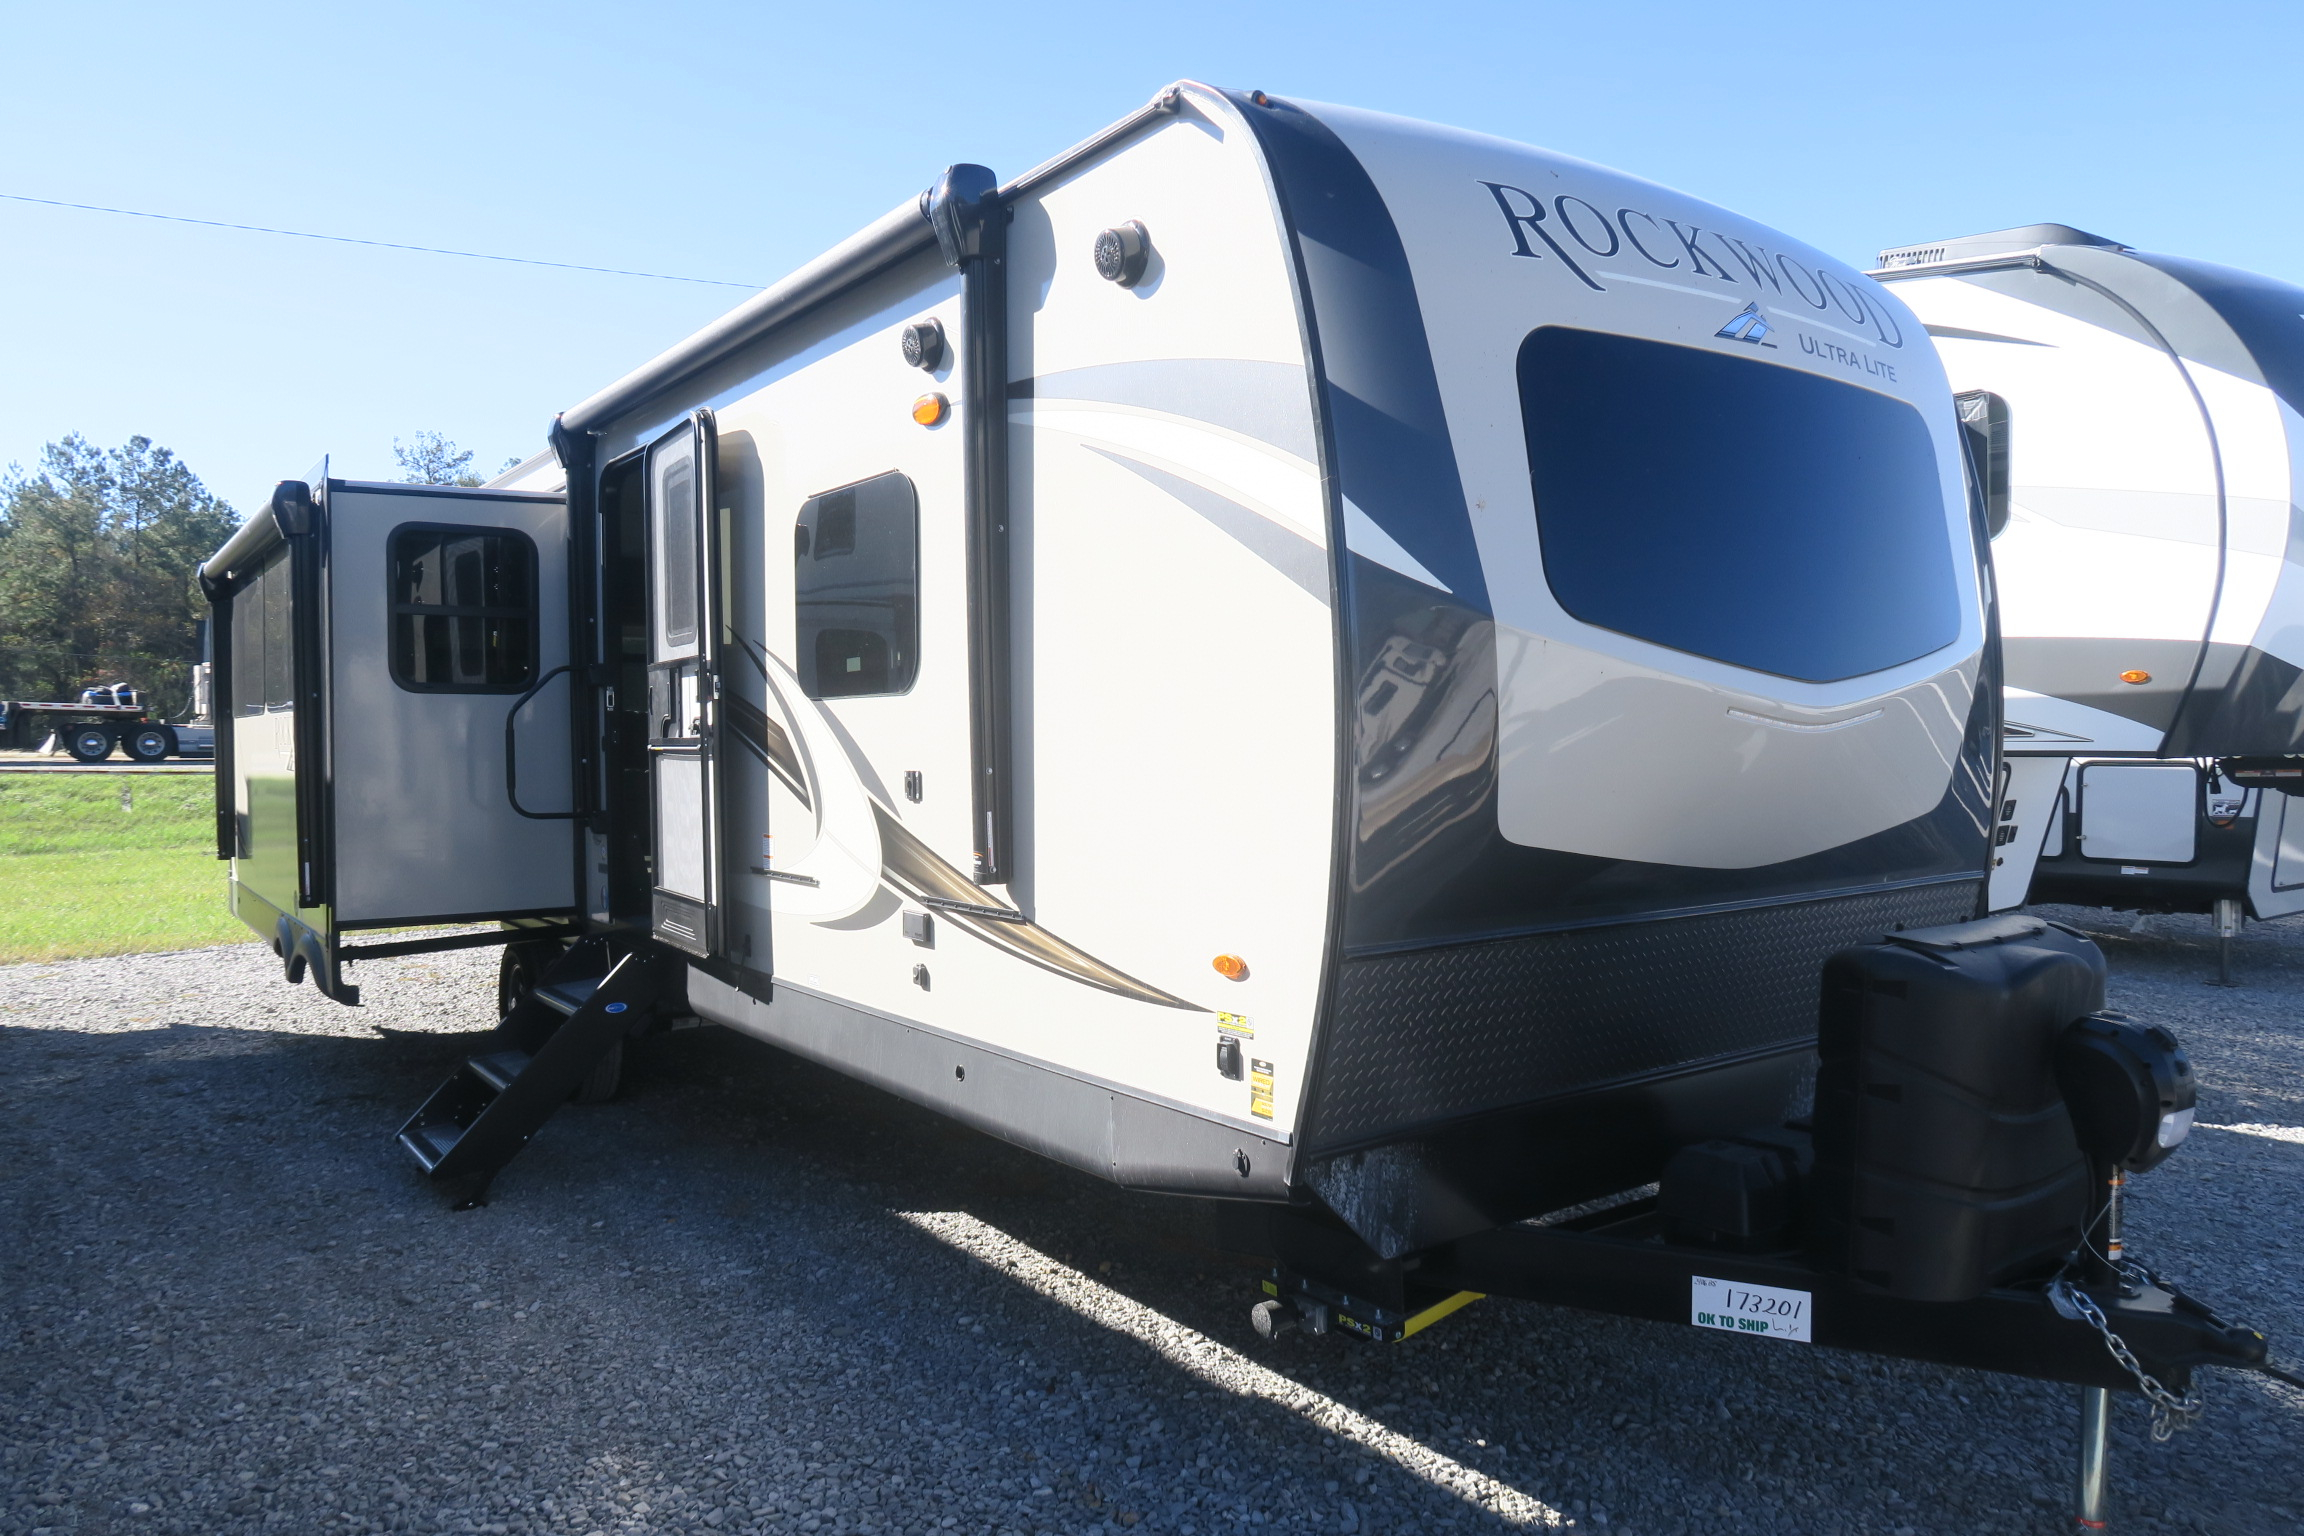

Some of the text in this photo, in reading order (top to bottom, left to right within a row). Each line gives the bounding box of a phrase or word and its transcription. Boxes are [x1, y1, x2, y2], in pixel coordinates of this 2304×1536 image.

[1475, 178, 1904, 350] ROCKWOOD
[1798, 332, 1898, 384] ULTRA LITE
[1726, 1288, 1802, 1319] 173201
[1339, 1313, 1371, 1333] PSx2
[1698, 1312, 1768, 1332] OK TO SHIP
